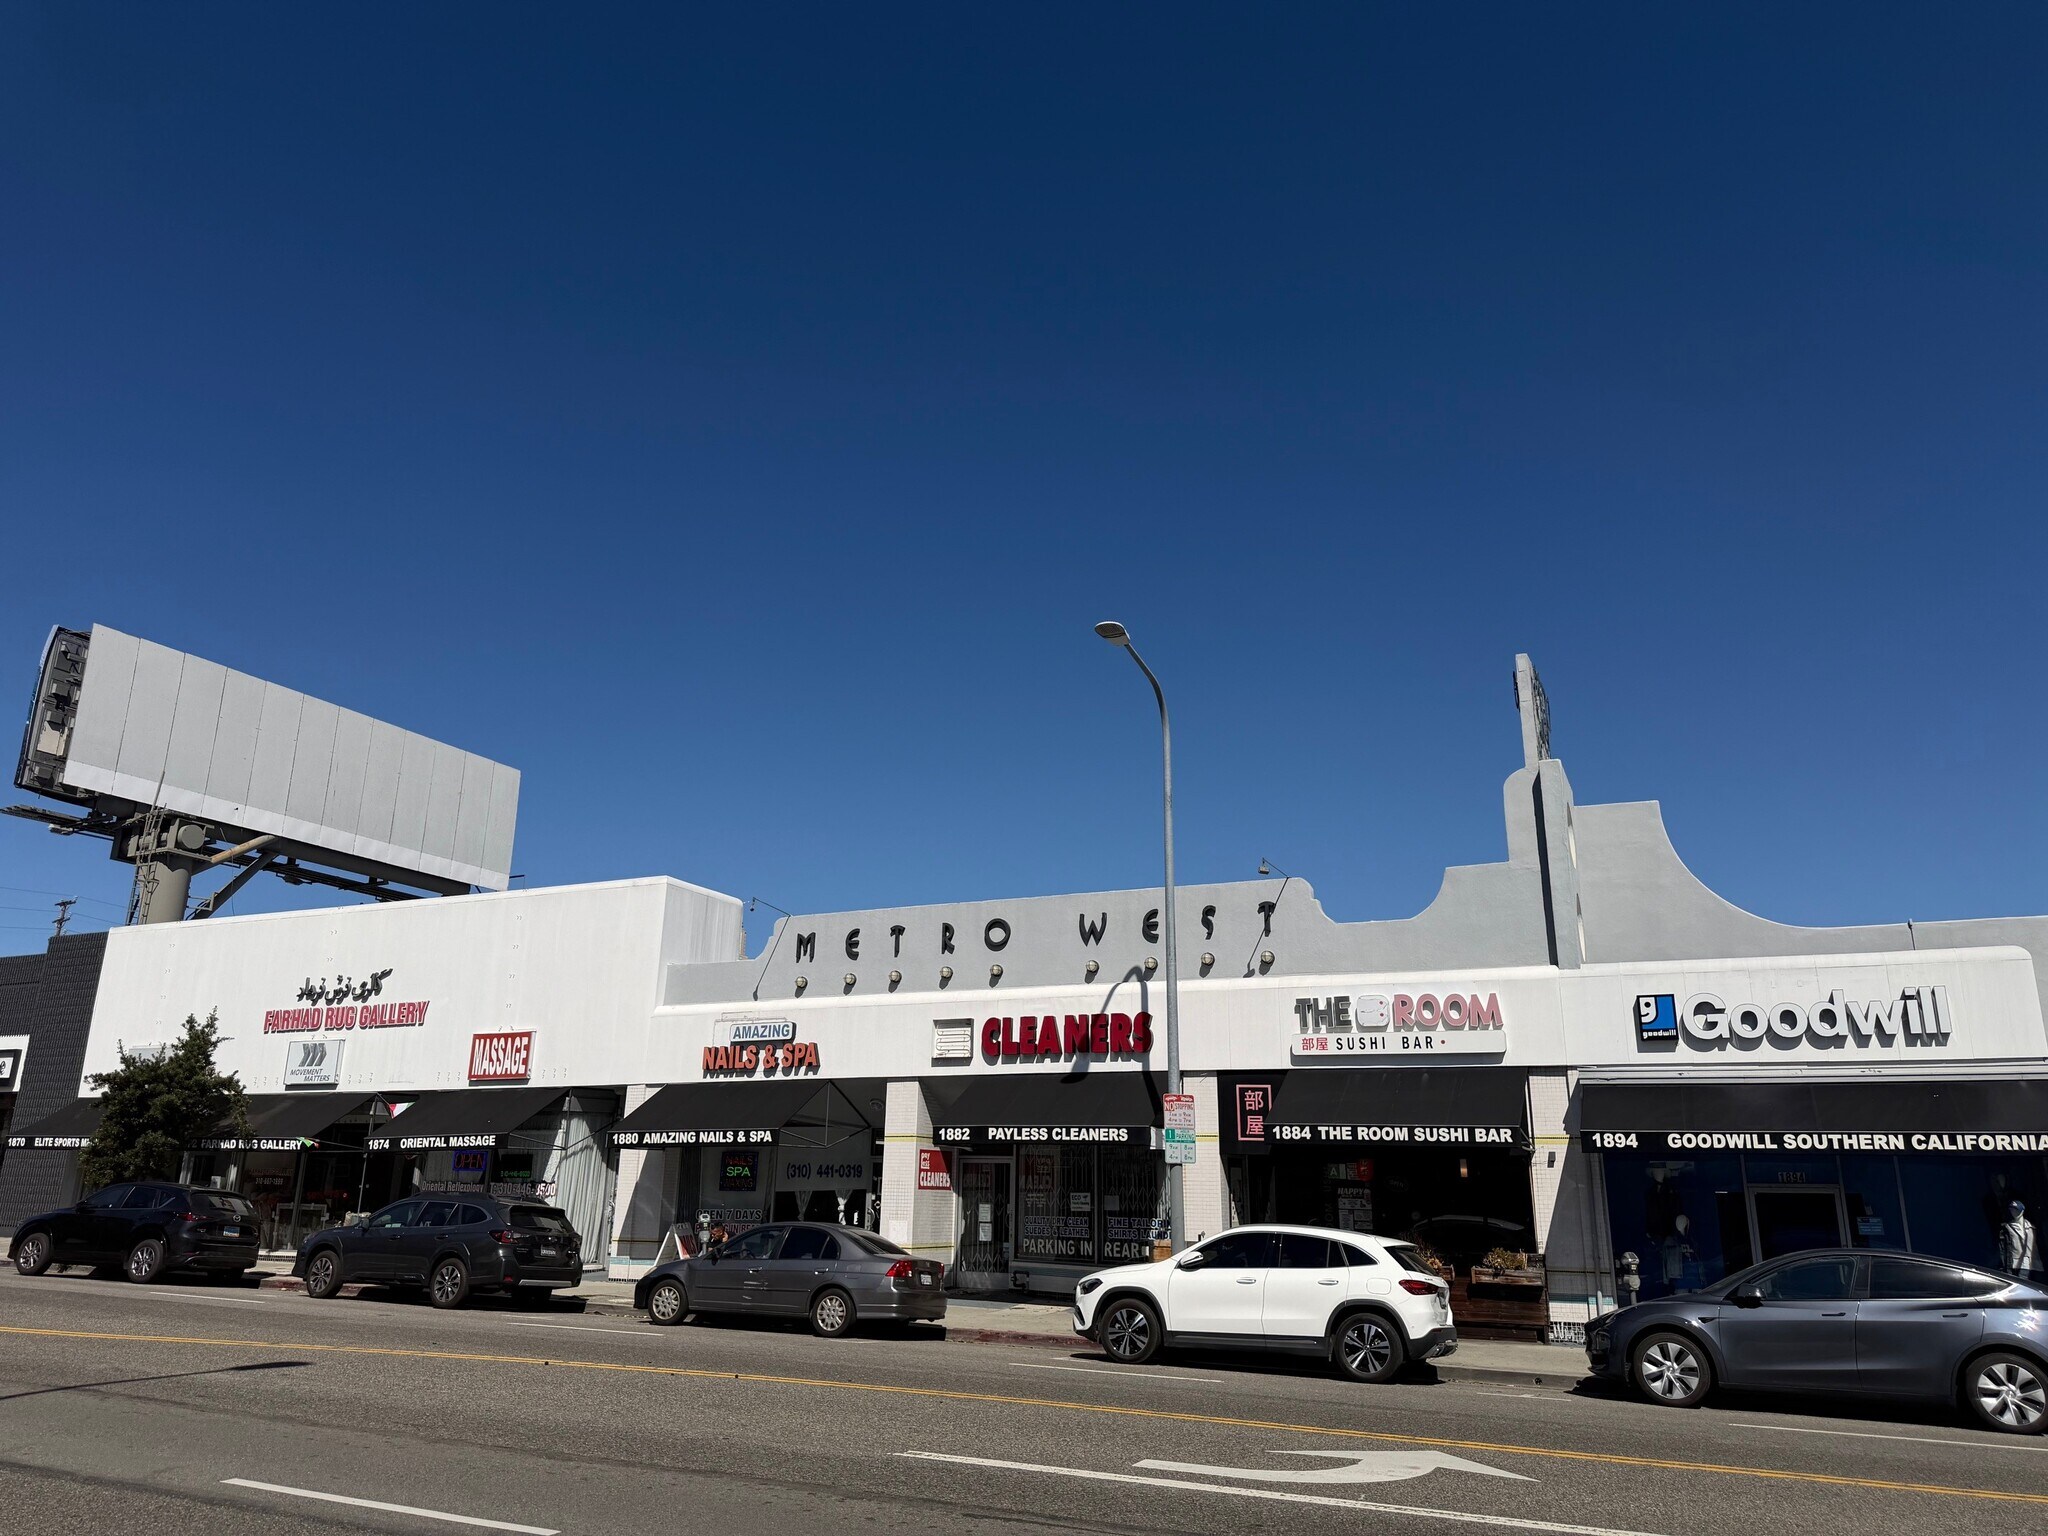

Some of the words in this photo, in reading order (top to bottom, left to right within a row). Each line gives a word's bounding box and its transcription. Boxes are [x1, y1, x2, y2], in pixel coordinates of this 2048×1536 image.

[795, 917, 1011, 963] METRO
[1078, 901, 1277, 947] WEST
[263, 1007, 324, 1034] FARHAD
[325, 1005, 358, 1031] RUG
[359, 1000, 430, 1029] GALLERY
[1294, 995, 1353, 1031] THE
[1392, 992, 1504, 1030] ROOM
[1681, 985, 1952, 1042] Goodwill
[732, 1023, 790, 1040] AMAZING
[981, 1011, 1154, 1059] CLEANERS
[1642, 1029, 1676, 1040] goodwill
[1301, 1037, 1329, 1051] 部屋
[1335, 1035, 1386, 1051] SUSHI
[1401, 1035, 1434, 1050] BAR
[471, 1035, 529, 1077] MASSAGE
[702, 1045, 760, 1071] NAILS
[762, 1043, 778, 1069] &
[781, 1042, 820, 1069] SPA
[289, 1068, 324, 1077] MOVEMENT
[303, 1074, 331, 1083] MATTERS
[1164, 1101, 1175, 1111] NO
[1244, 1090, 1265, 1135] 部屋
[612, 1132, 639, 1144] 1880
[642, 1132, 697, 1144] AMAZING
[698, 1131, 734, 1144] NAILS
[736, 1131, 747, 1143] &
[749, 1130, 773, 1142] SPA
[938, 1127, 971, 1141] 1882
[988, 1127, 1049, 1141] PAYLESS
[1051, 1127, 1129, 1142] CLEANERS
[1271, 1125, 1312, 1141] 1884
[1317, 1126, 1353, 1141] THE
[1357, 1126, 1409, 1142] ROOM
[1413, 1127, 1469, 1143] SUSHI
[1474, 1128, 1514, 1143] BAR
[8, 1137, 26, 1147] 1870
[34, 1137, 54, 1147] ELITE
[53, 1137, 80, 1148] SPORTS
[200, 1138, 237, 1149] FARHAD
[238, 1139, 259, 1150] RUG
[260, 1139, 303, 1150] GALLERY
[368, 1139, 390, 1150] 1874
[399, 1137, 447, 1149] ORIENTAL
[449, 1135, 497, 1148] MASSAGE
[1592, 1132, 1639, 1148] 1894
[1667, 1132, 1778, 1149] GOODWILL
[1782, 1133, 1905, 1151] SOUTHERN
[1911, 1134, 2048, 1152] CALIFORNIA
[453, 1152, 484, 1169] OPEN
[726, 1166, 752, 1177] SPA
[786, 1162, 812, 1180] (310)
[816, 1163, 863, 1179] 441-0319
[421, 1180, 447, 1192] Oriental
[919, 1171, 951, 1188] CLEANERS
[726, 1209, 734, 1221] 7
[735, 1208, 763, 1221] DAYS
[1024, 1215, 1052, 1227] QUALITY
[1051, 1216, 1067, 1227] DRY
[1107, 1216, 1129, 1228] FINE
[1130, 1217, 1172, 1229] TAILORIN
[1024, 1225, 1052, 1237] SUEDES
[1059, 1226, 1090, 1238] LEATHER
[1108, 1228, 1139, 1239] SHIRTS
[1139, 1229, 1172, 1240] LAUND
[1023, 1238, 1076, 1255] PARKING
[1080, 1240, 1093, 1256] IN
[1104, 1241, 1139, 1259] REAR
